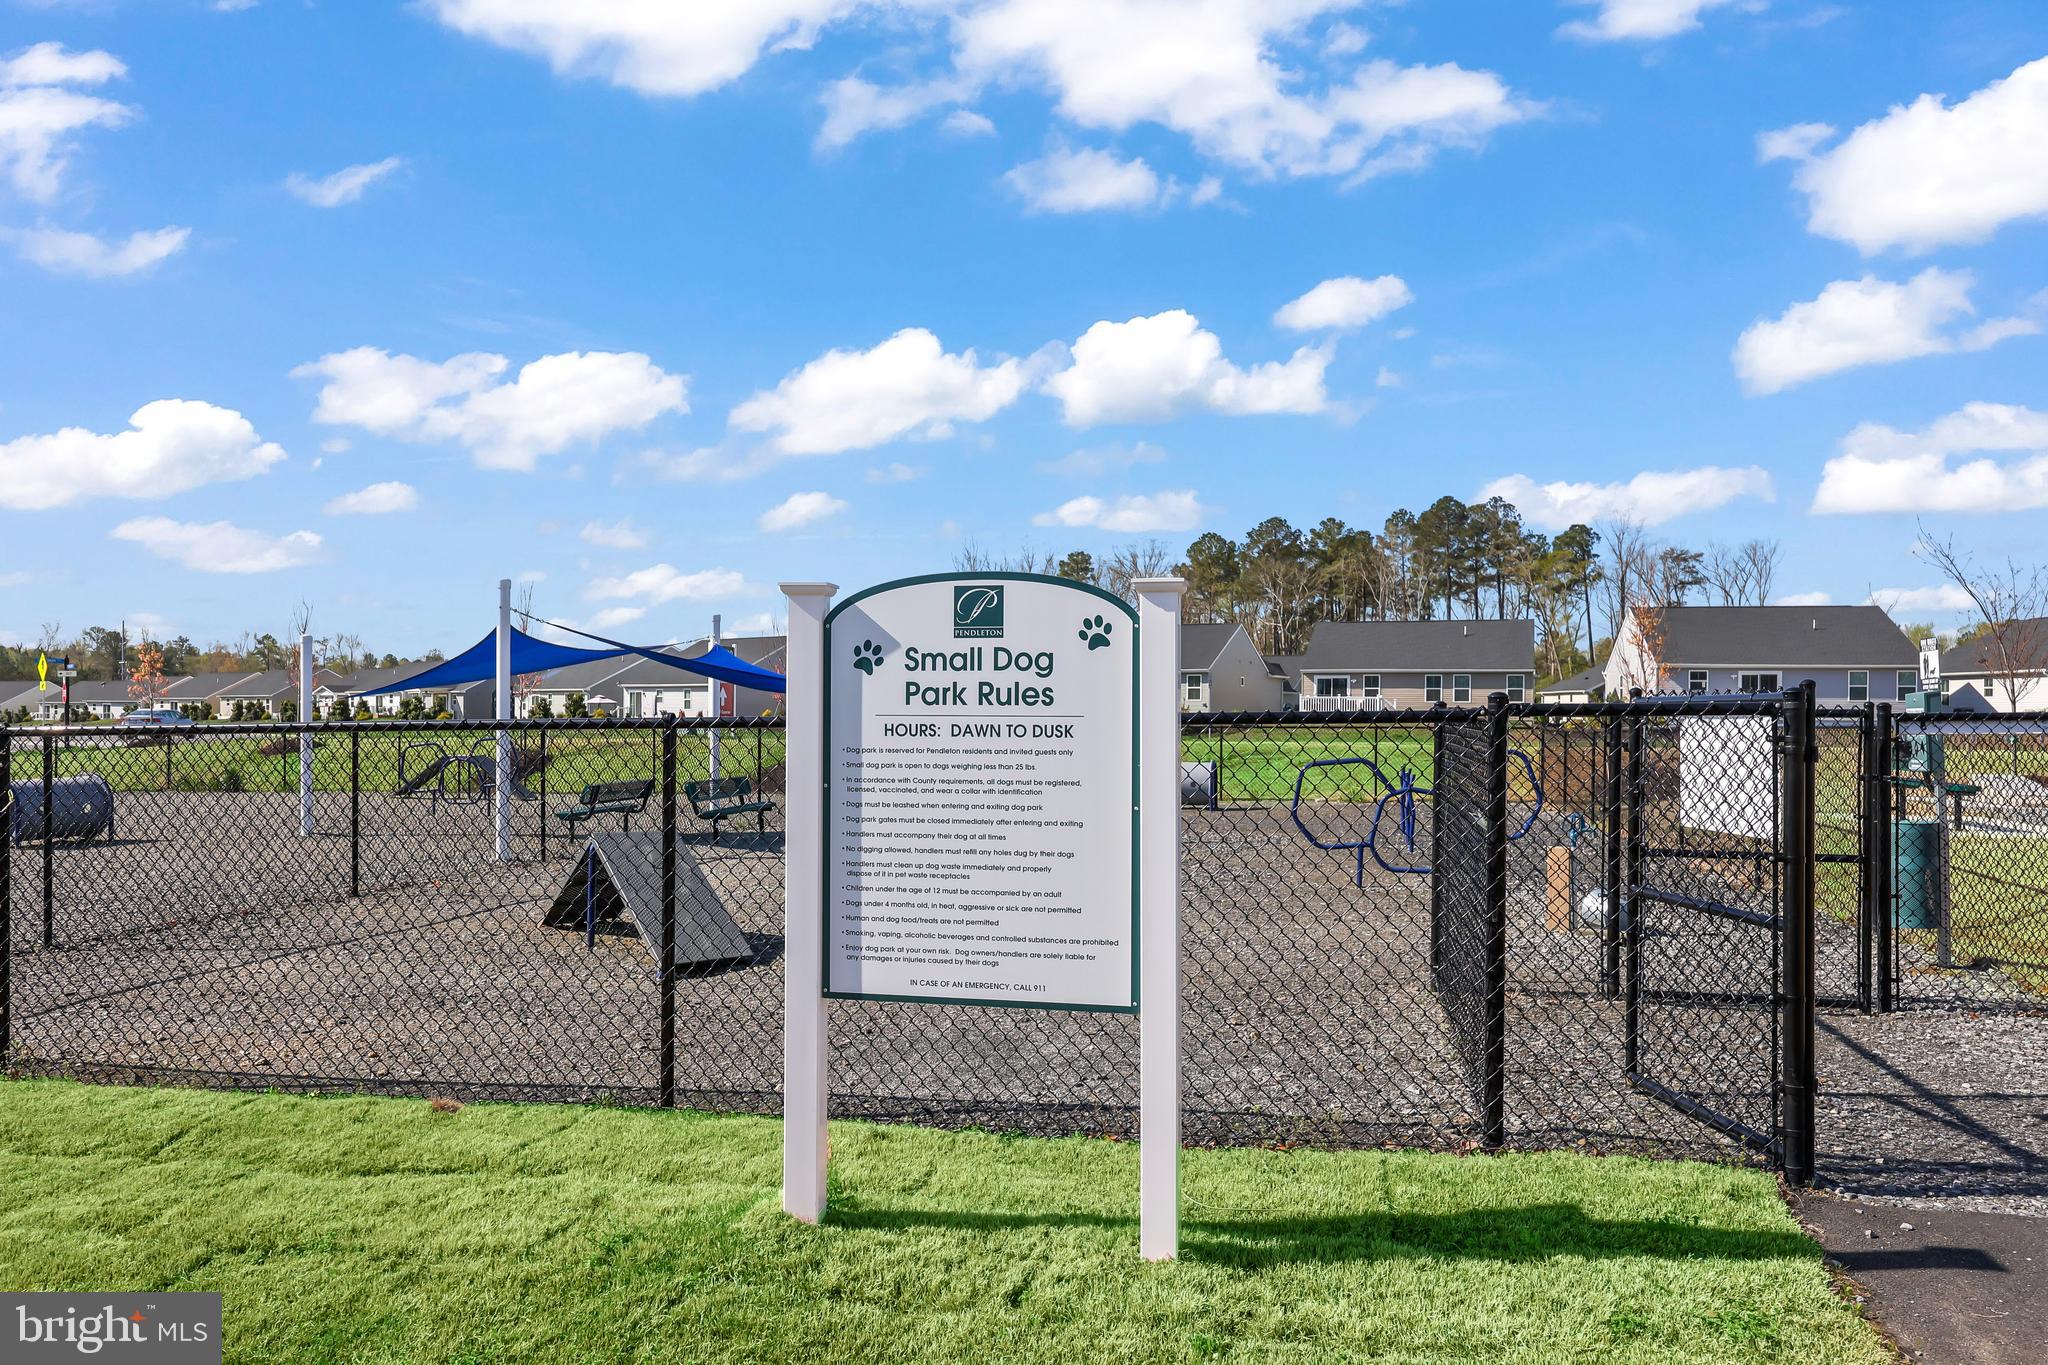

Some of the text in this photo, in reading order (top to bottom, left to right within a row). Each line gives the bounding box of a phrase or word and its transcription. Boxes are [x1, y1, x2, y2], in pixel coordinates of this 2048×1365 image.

[955, 629, 1003, 637] PENDLETON
[904, 646, 1054, 678] Small Dog
[905, 681, 1054, 706] Park Rules
[884, 723, 1074, 738] HOURS: DAWN TO DUSK
[846, 746, 860, 755] Dog
[861, 746, 876, 755] park
[1034, 748, 1056, 757] guests
[1058, 748, 1073, 757] only
[853, 776, 895, 784] accordance
[897, 776, 910, 784] with
[912, 777, 936, 786] County
[996, 778, 1013, 787] dogs
[1033, 778, 1043, 786] be
[920, 786, 934, 794] and
[846, 800, 862, 809] Dogs
[941, 802, 969, 811] entering
[970, 802, 984, 810] and
[986, 802, 1009, 812] exiting
[1011, 803, 1025, 812] dog
[1026, 803, 1043, 812] park
[846, 815, 859, 824] Dog
[861, 815, 876, 824] park
[878, 816, 897, 824] gates
[916, 816, 925, 824] be
[926, 816, 950, 824] closed
[952, 817, 994, 826] immediately
[1013, 818, 1042, 828] entering
[1060, 819, 1083, 828] exiting
[846, 830, 874, 838] Handlers
[894, 832, 935, 840] accompany
[954, 832, 967, 841] dog
[978, 832, 986, 840] all
[988, 832, 1006, 840] times
[856, 845, 882, 855] digging
[1013, 849, 1027, 858] dug
[1029, 849, 1038, 858] by
[1056, 850, 1074, 859] dogs
[876, 860, 892, 868] must
[925, 862, 939, 870] dog
[962, 862, 1005, 872] immediately
[1022, 864, 1051, 873] properly
[846, 899, 862, 908] Dogs
[864, 899, 883, 907] under
[890, 900, 915, 908] months
[958, 902, 995, 912] aggressive
[1047, 905, 1081, 915] permitted
[846, 914, 869, 922] Human
[886, 915, 899, 924] dog
[901, 916, 938, 924] food/treats
[952, 917, 964, 925] not
[966, 918, 999, 927] permitted
[904, 931, 935, 939] alcoholic
[937, 932, 974, 942] beverages
[991, 934, 1026, 942] controlled
[1028, 936, 1067, 944] substances
[1082, 938, 1118, 947] prohibited
[846, 944, 863, 953] Enjoy
[864, 944, 878, 953] dog
[880, 945, 895, 954] park
[906, 947, 920, 955] your
[955, 948, 969, 957] Dog
[970, 948, 1028, 958] owners/handlers
[1043, 951, 1063, 961] solely
[1064, 952, 1084, 960] liable
[847, 954, 859, 962] any
[860, 953, 892, 963] damages
[902, 955, 925, 964] injuries
[927, 956, 953, 964] caused
[954, 957, 963, 966] by
[982, 958, 999, 967] dogs
